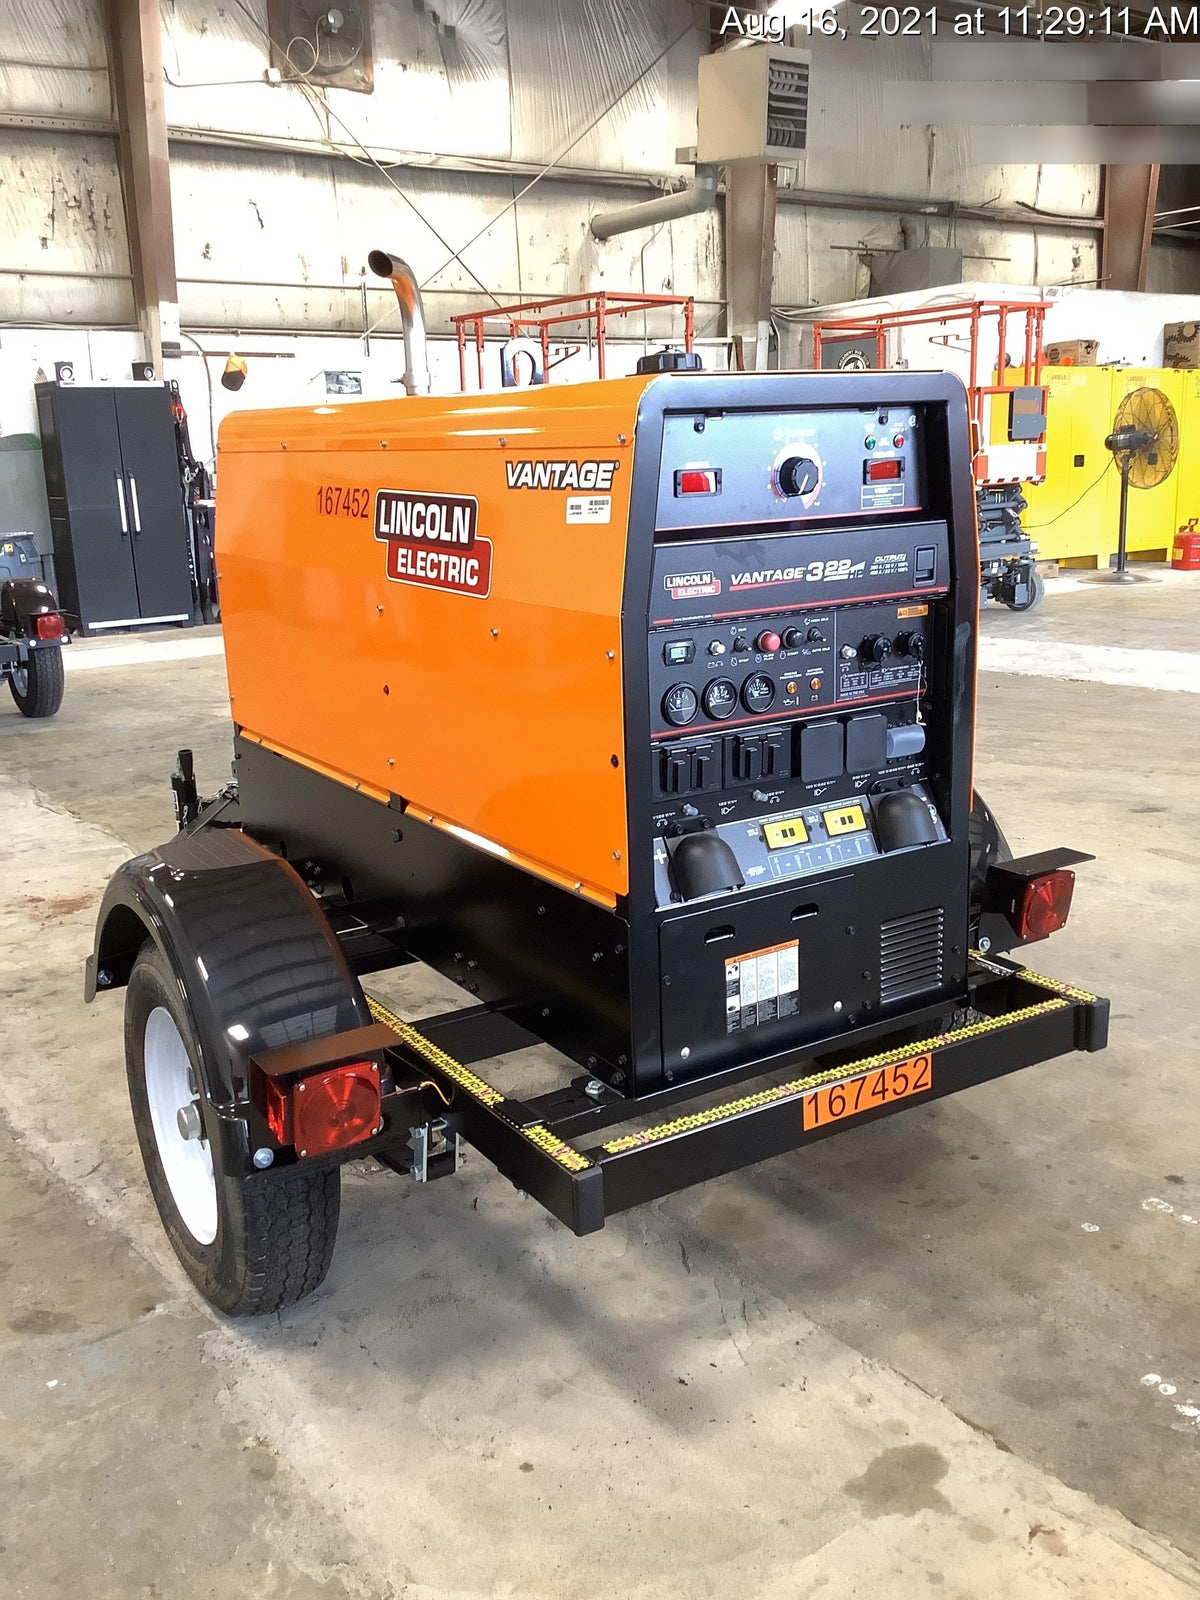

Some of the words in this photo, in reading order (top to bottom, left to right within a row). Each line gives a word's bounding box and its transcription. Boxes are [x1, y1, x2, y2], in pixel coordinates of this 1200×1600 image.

[506, 461, 614, 490] VANTAGE
[316, 486, 370, 518] 167452
[379, 499, 471, 544] LINCOLN
[397, 548, 479, 586] ELECTRIC
[731, 567, 803, 585] VANTAGE
[806, 559, 852, 582] 322
[875, 554, 904, 562] OUTPUT
[667, 574, 710, 588] LINCOLN
[677, 585, 716, 596] ELECTRIC
[404, 1031, 421, 1045] PAS
[418, 1041, 441, 1060] TENEZ
[439, 1056, 472, 1083] DEBOUT
[875, 1044, 920, 1063] DEBOUT
[807, 1056, 929, 1124] 167452
[649, 1125, 670, 1138] DO
[672, 1115, 700, 1130] NOT
[701, 1100, 745, 1120] STAND
[745, 1089, 778, 1106] HERE
[535, 1132, 557, 1148] AQUI
